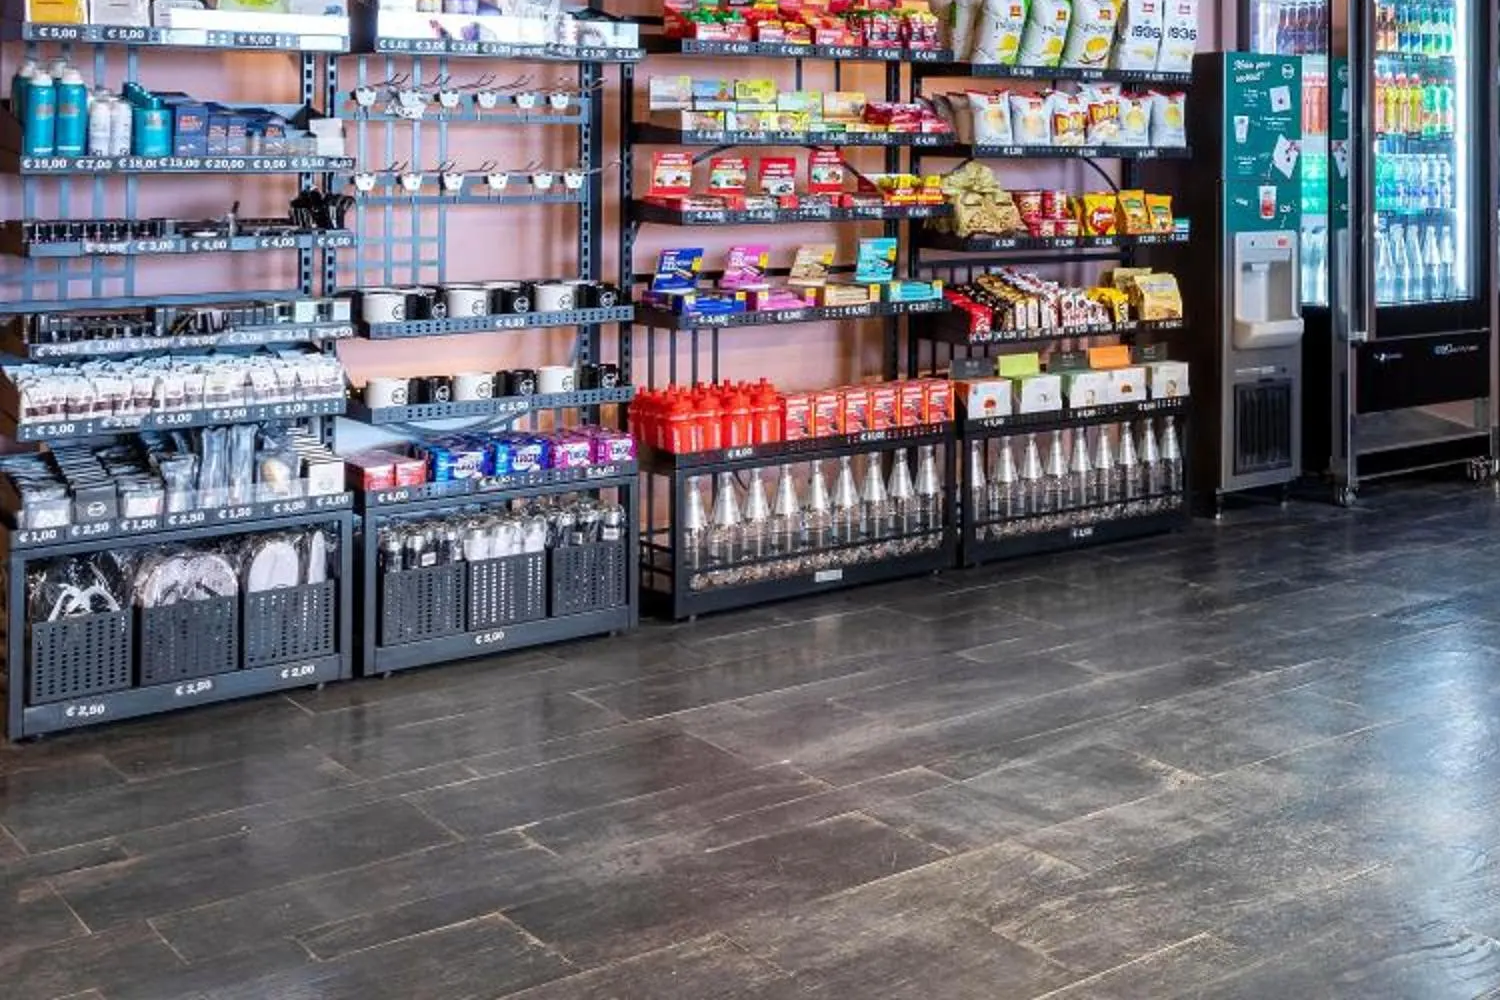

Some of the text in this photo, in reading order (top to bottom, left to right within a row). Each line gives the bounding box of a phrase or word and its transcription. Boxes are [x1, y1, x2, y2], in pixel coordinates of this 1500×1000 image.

[51, 27, 77, 40] 5,00
[1132, 25, 1160, 39] 1936
[1167, 27, 1197, 41] 1936
[166, 413, 192, 425] 3,00
[47, 424, 75, 436] 3,00
[31, 529, 57, 542] 1,00
